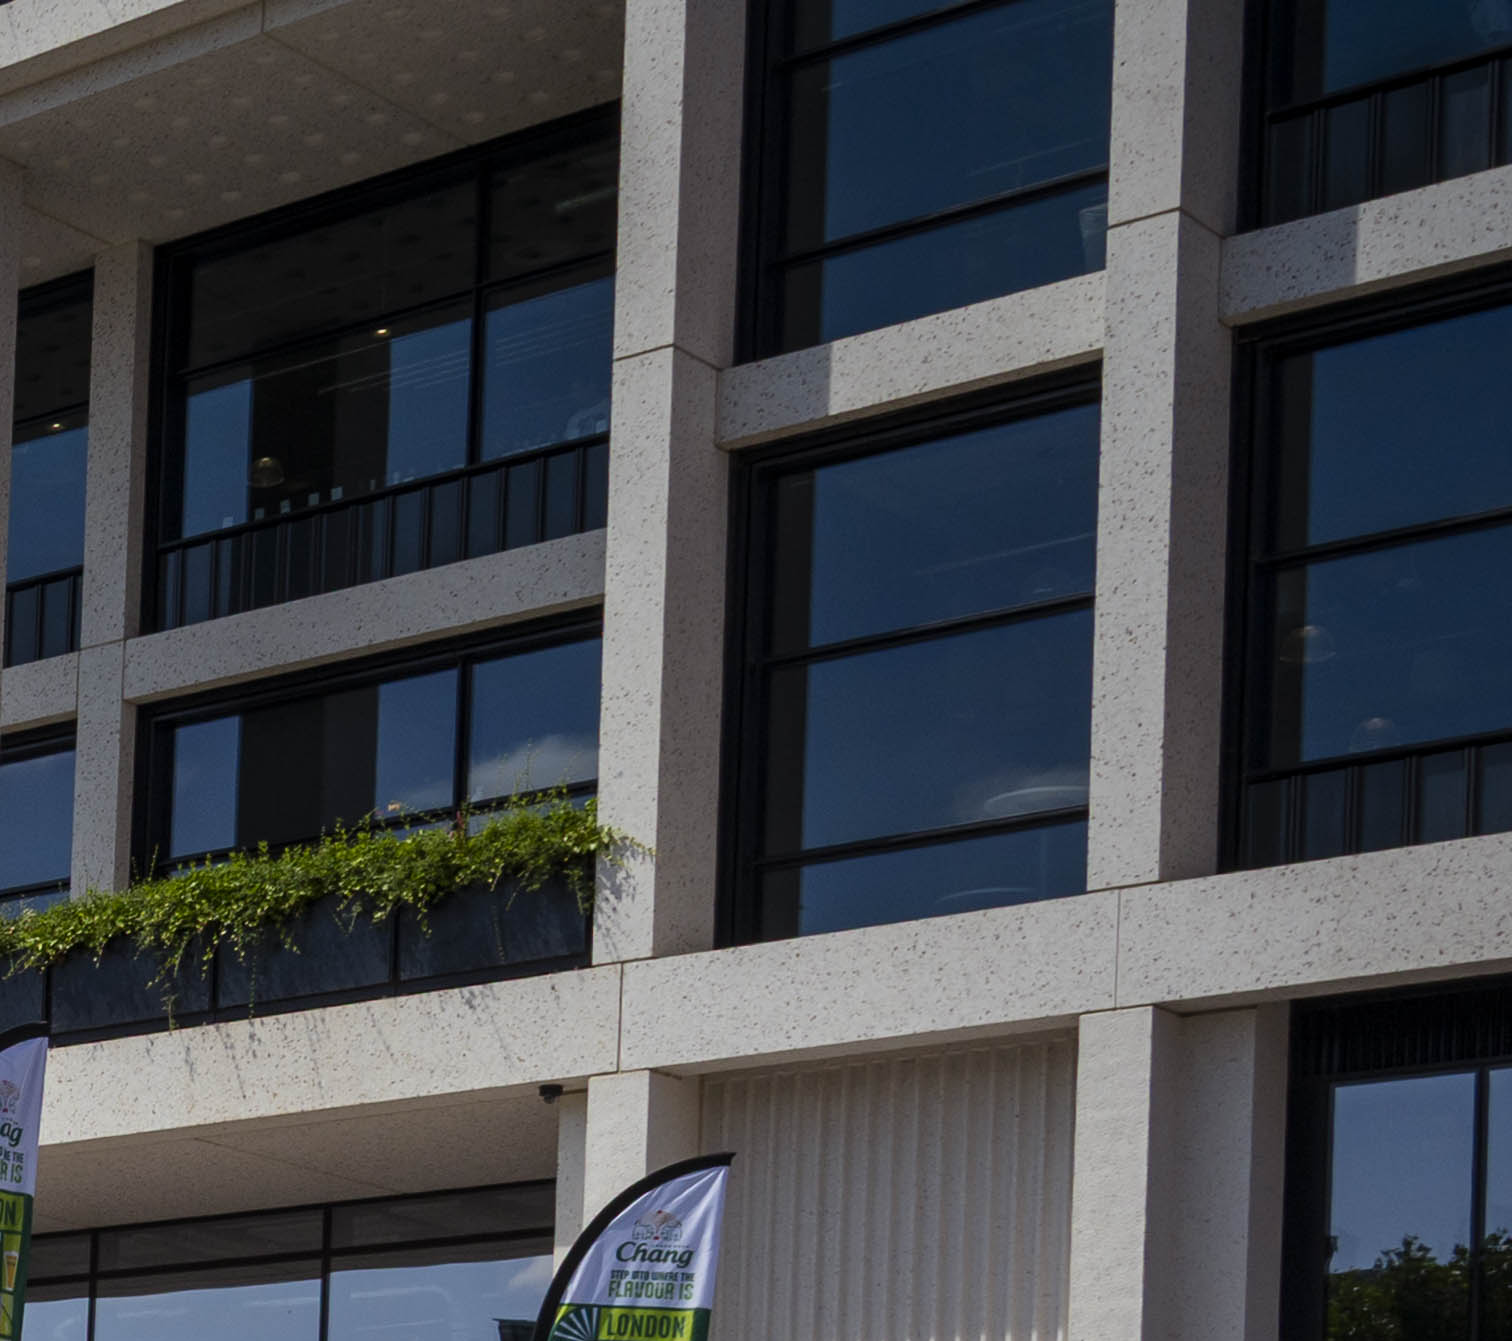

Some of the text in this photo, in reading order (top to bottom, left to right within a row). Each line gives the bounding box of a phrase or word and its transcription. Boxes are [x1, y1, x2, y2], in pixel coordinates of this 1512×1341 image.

[616, 1241, 694, 1268] Chang
[608, 1280, 694, 1300] FLAVOUR IS
[607, 1310, 686, 1338] LONDON
